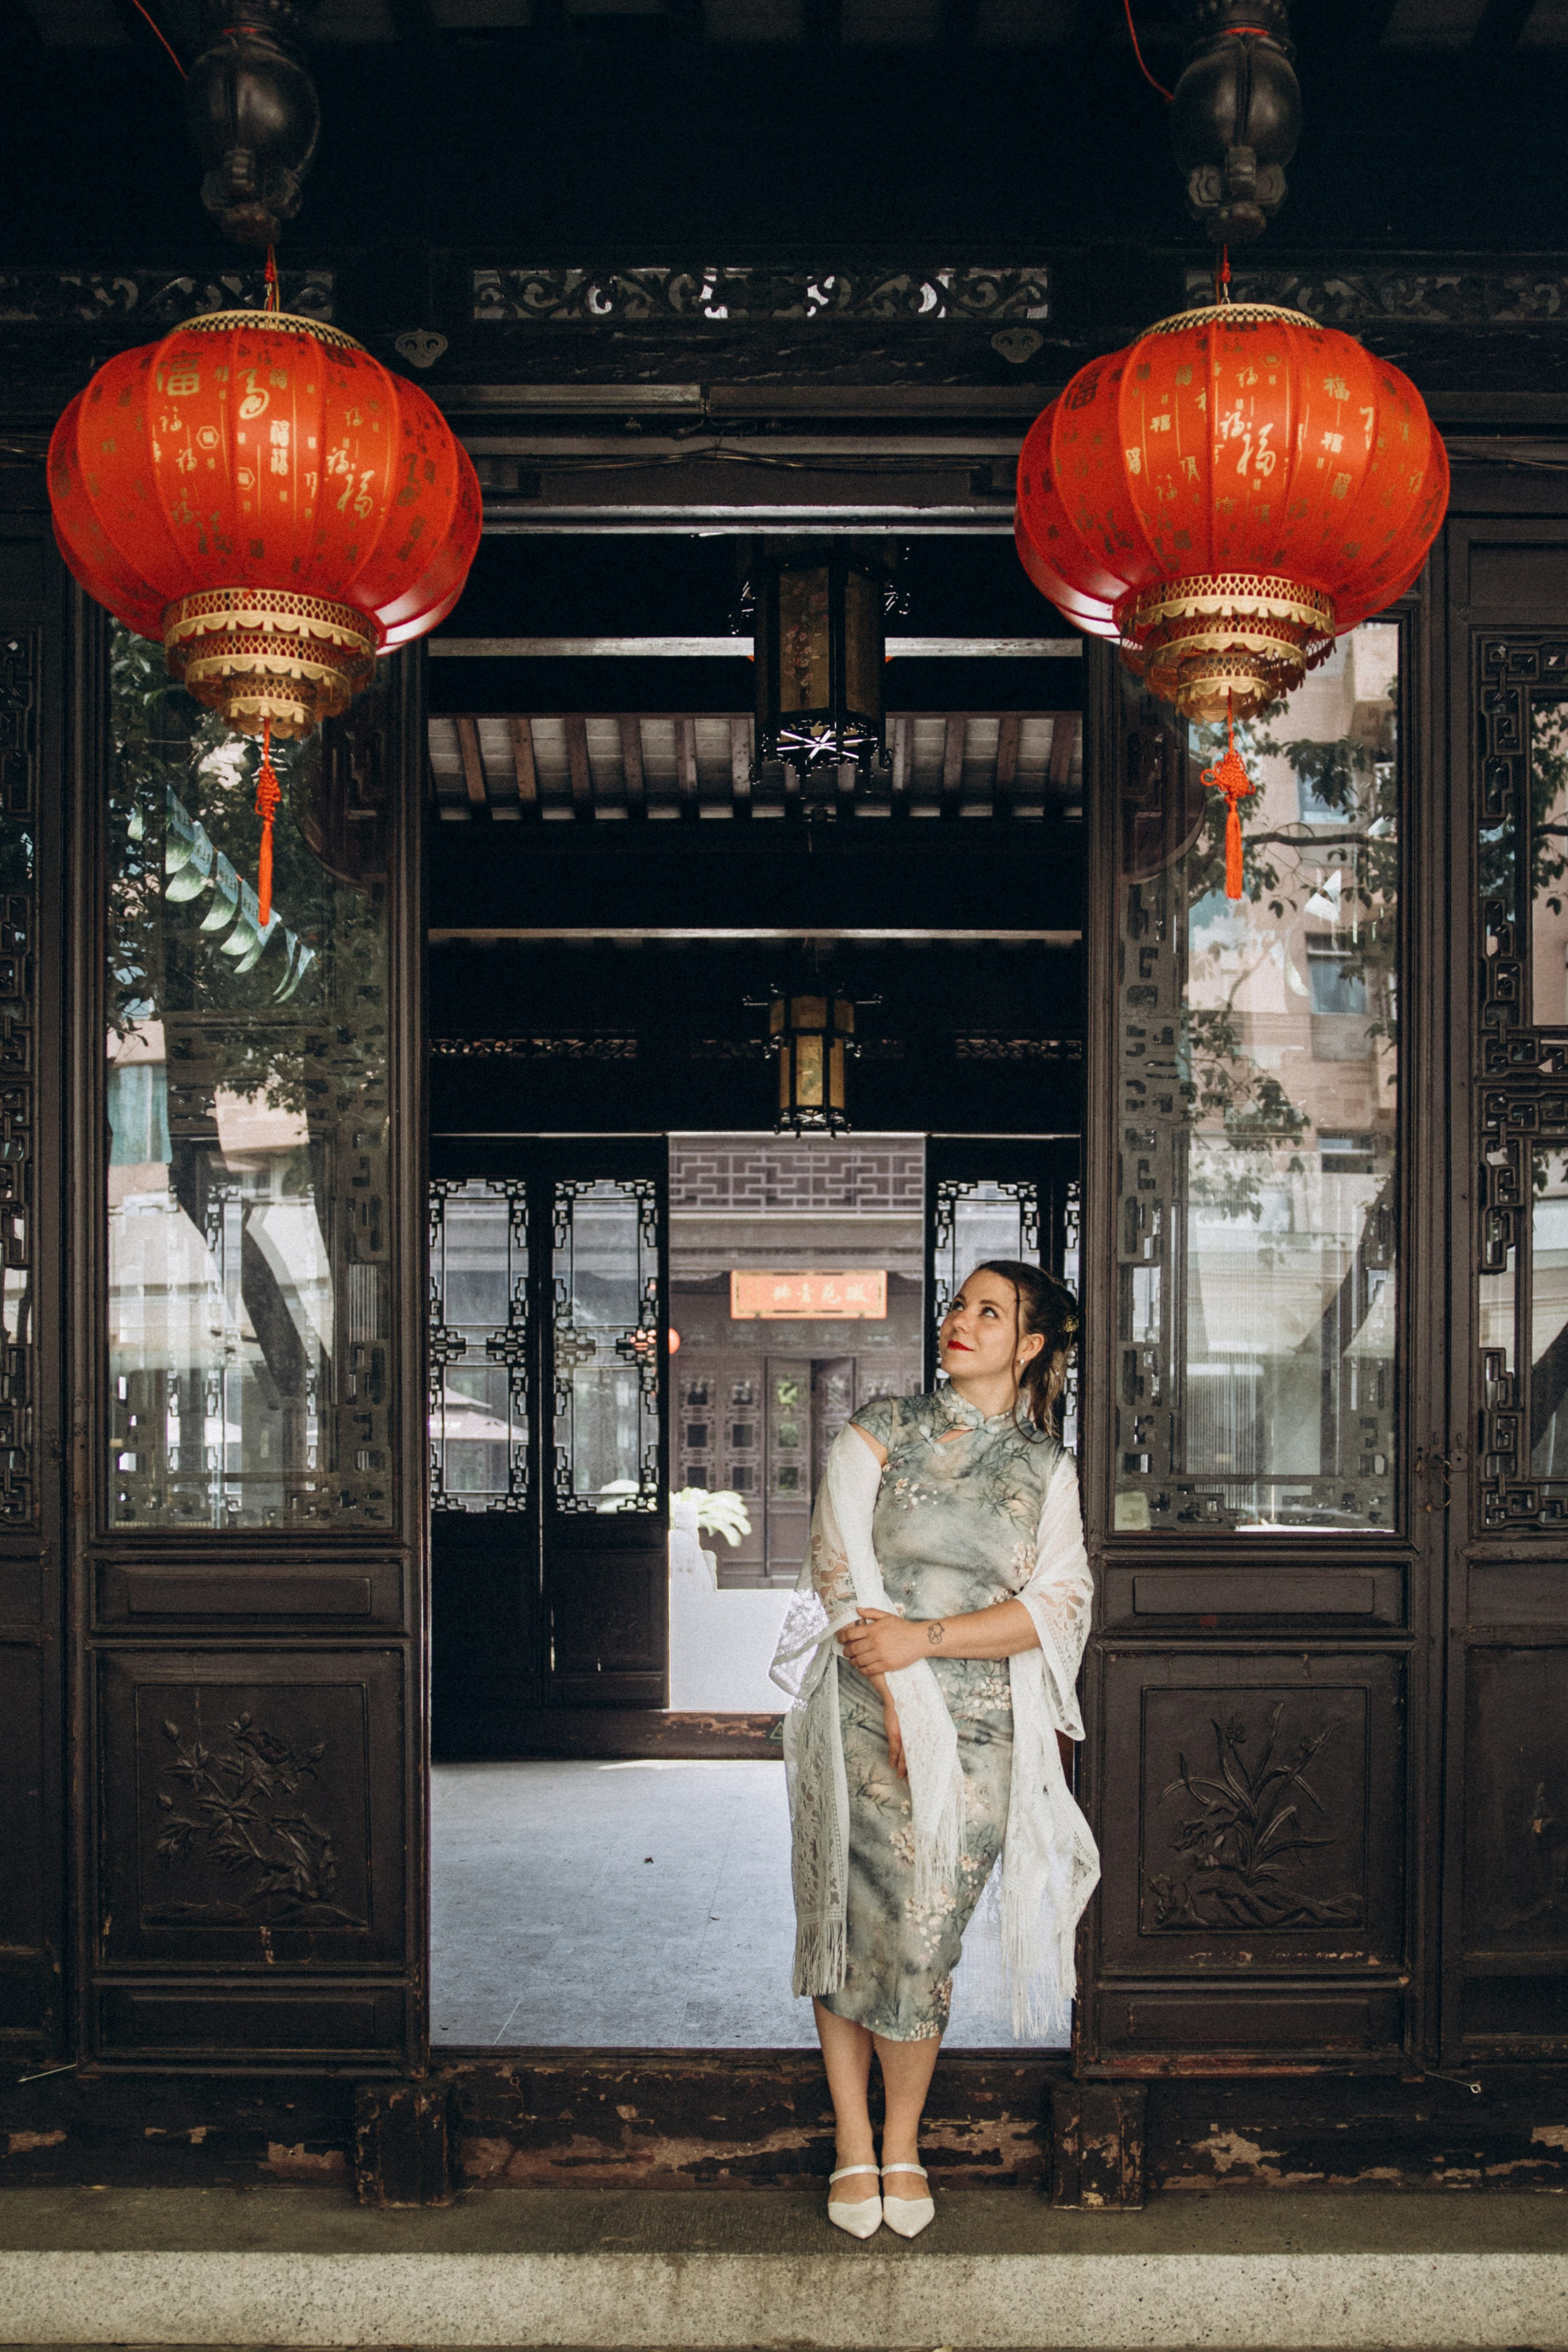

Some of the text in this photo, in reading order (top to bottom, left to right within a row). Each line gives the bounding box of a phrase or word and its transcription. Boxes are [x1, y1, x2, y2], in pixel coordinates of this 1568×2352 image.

[156, 350, 200, 396] 福
[1323, 372, 1350, 402] 福
[1237, 423, 1276, 477] 福
